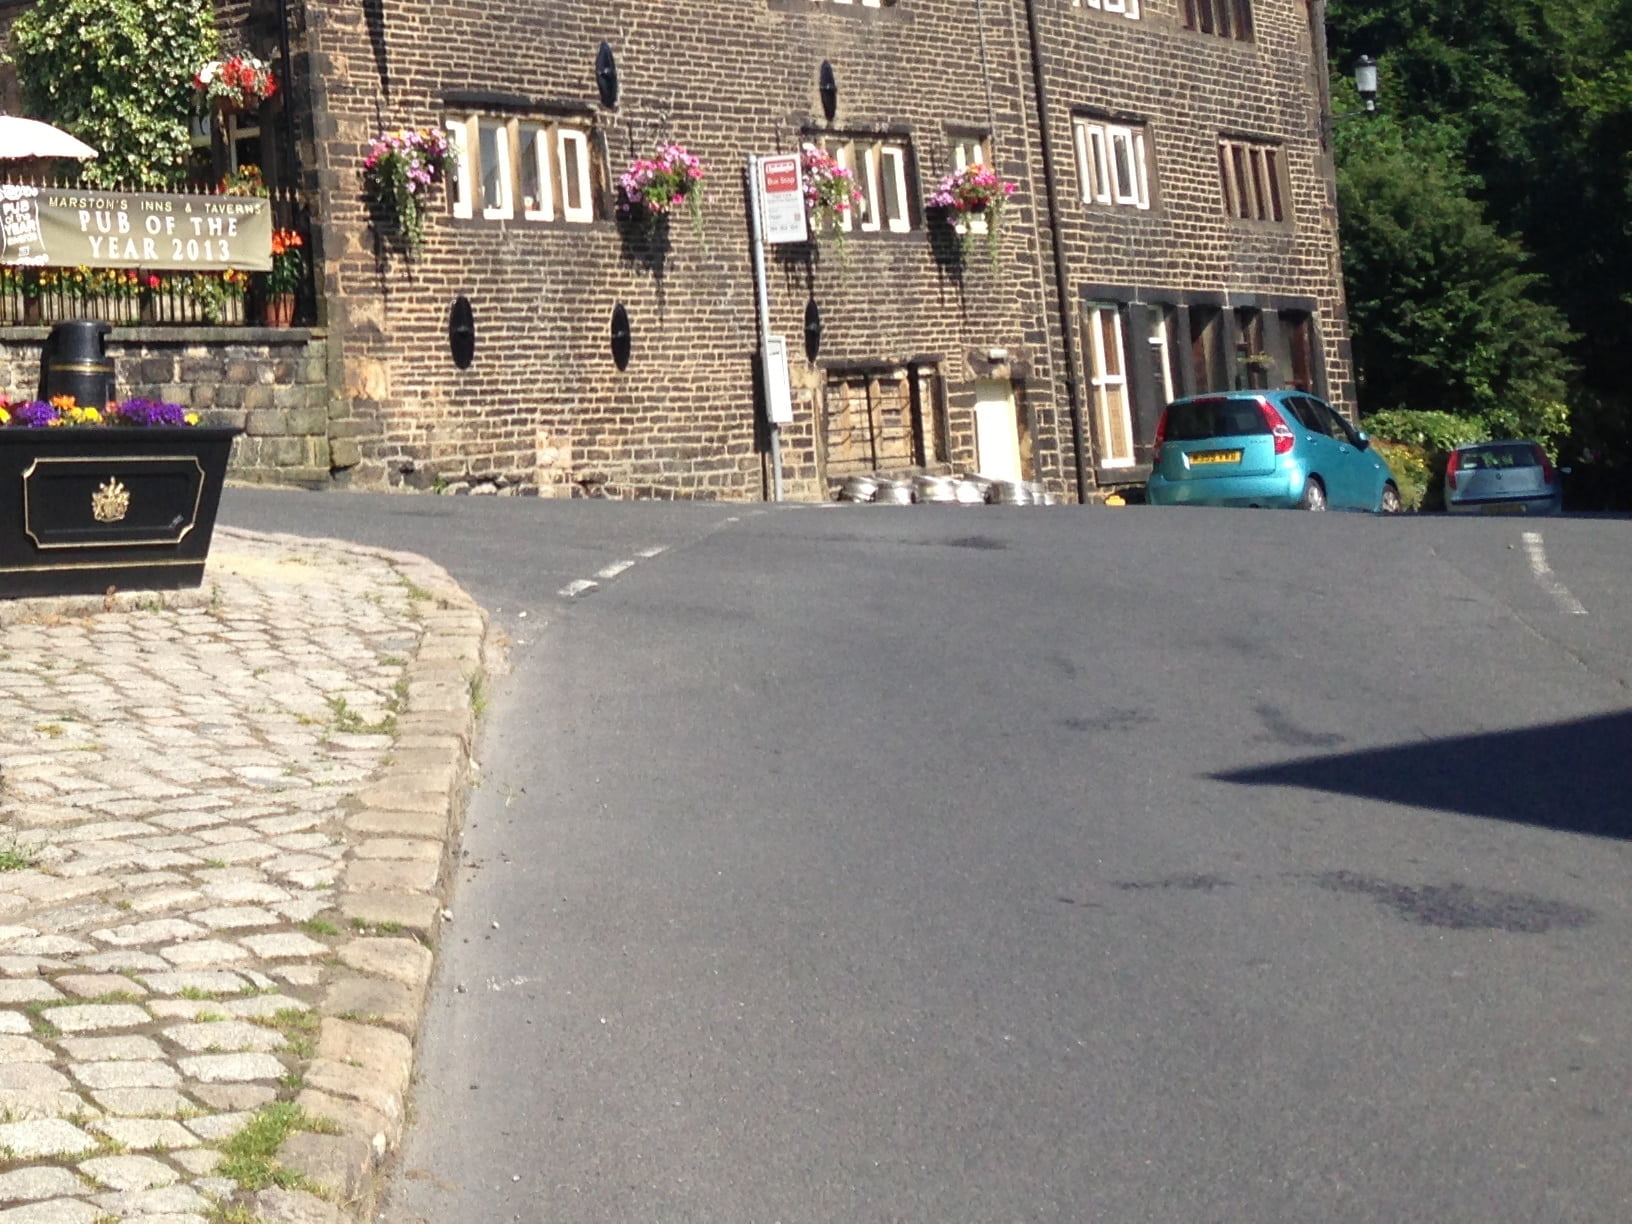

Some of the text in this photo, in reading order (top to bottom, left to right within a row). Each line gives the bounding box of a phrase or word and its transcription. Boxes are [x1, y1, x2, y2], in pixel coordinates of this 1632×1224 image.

[780, 176, 795, 185] Stop
[3, 200, 30, 215] PUB
[49, 196, 261, 215] MARSTON'S INNS & TAVERNS
[16, 212, 31, 222] the
[78, 210, 238, 237] PUB OF THE
[5, 219, 37, 236] YEAR
[88, 235, 230, 261] YEAR 2013
